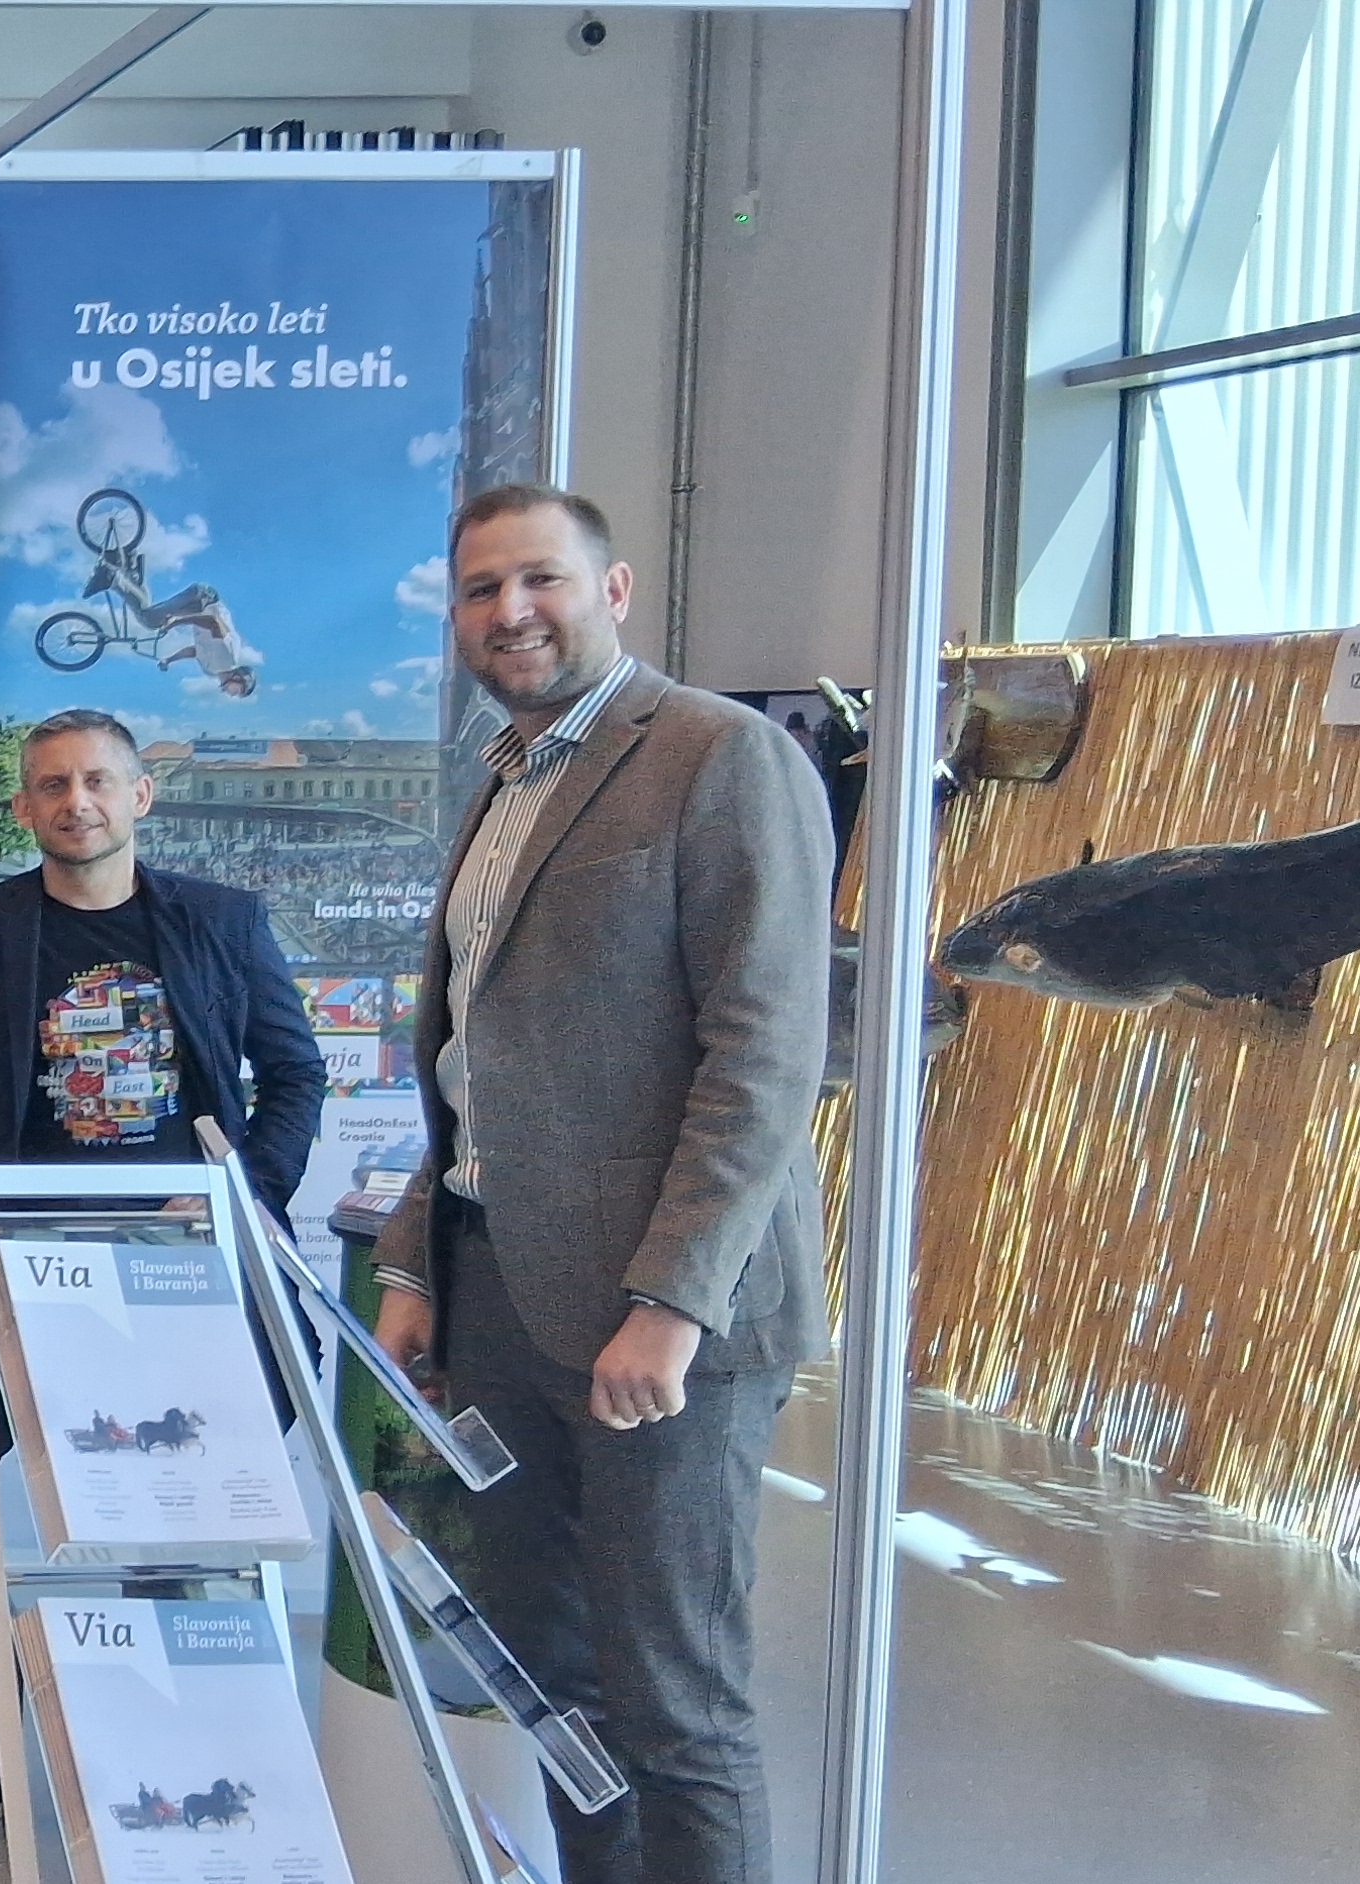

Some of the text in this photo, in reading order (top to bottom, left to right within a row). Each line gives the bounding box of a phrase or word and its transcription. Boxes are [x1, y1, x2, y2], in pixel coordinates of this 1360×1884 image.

[73, 301, 329, 335] Tko visoko leti
[71, 344, 408, 401] u Osijek sleti.
[372, 882, 403, 897] who
[314, 899, 436, 919] lands in Os
[70, 1012, 110, 1028] Head
[82, 1056, 103, 1067] On
[112, 1081, 145, 1094] East
[23, 1255, 93, 1290] Via
[129, 1259, 206, 1276] Slavonija
[133, 1277, 209, 1294] i Baranja
[64, 1612, 136, 1648] Via
[172, 1615, 251, 1633] Slavonija
[177, 1634, 255, 1652] i Baranja
